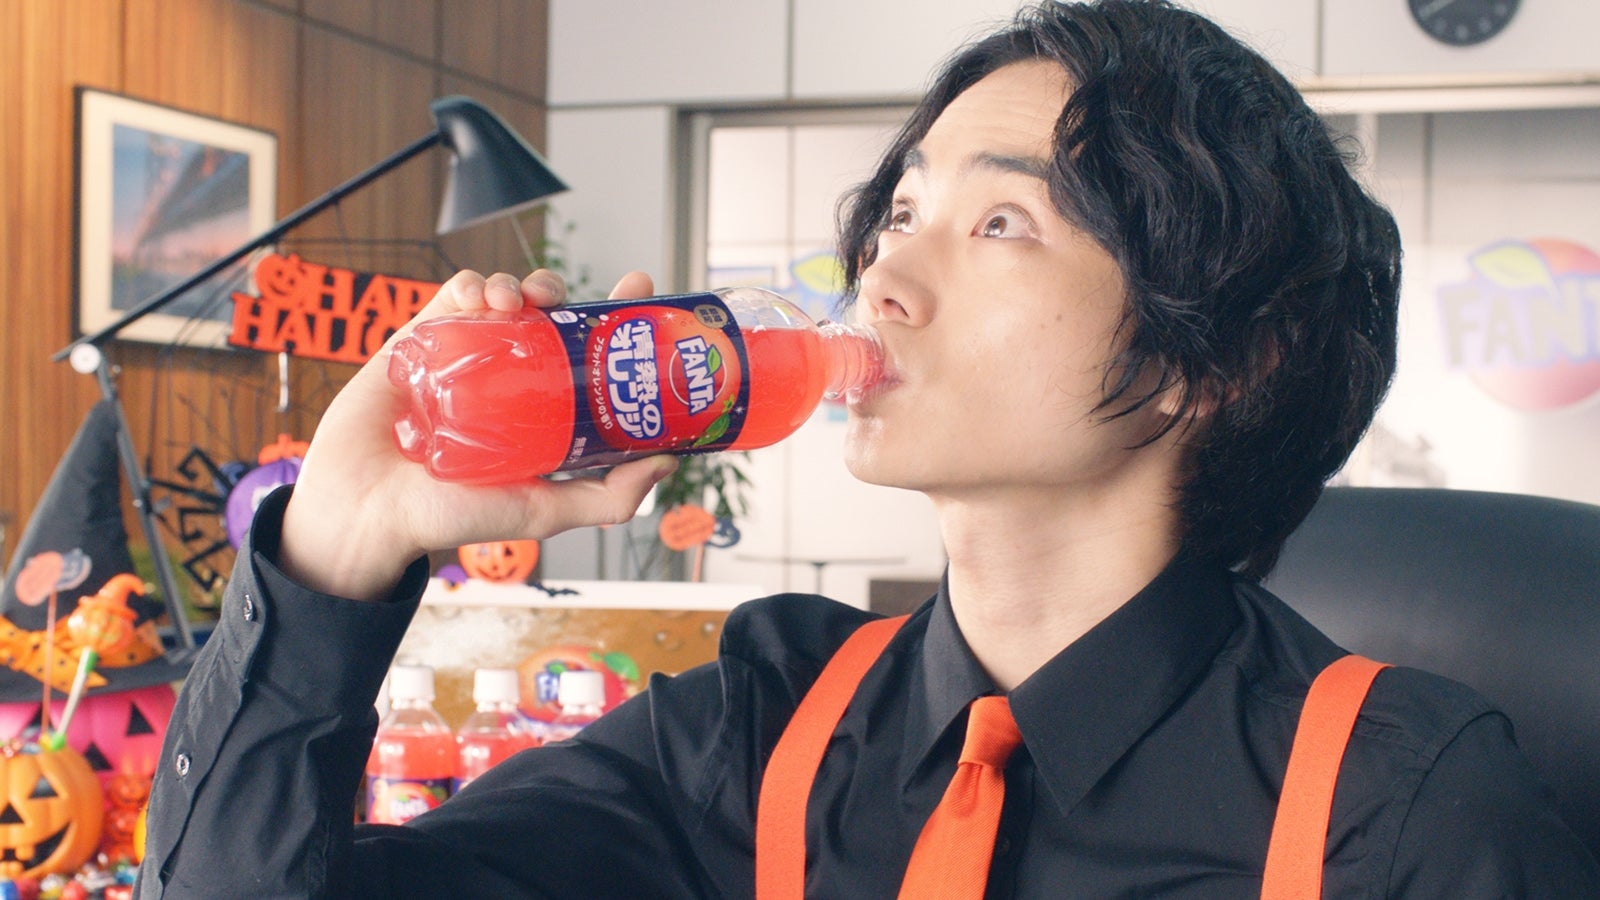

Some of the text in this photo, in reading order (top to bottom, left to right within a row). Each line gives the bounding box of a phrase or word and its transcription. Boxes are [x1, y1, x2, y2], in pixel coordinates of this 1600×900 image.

[592, 336, 613, 430] ブラッドオレンジの香り
[607, 323, 644, 438] オレンジ
[631, 321, 661, 437] 情熱の
[677, 337, 715, 414] FANTA
